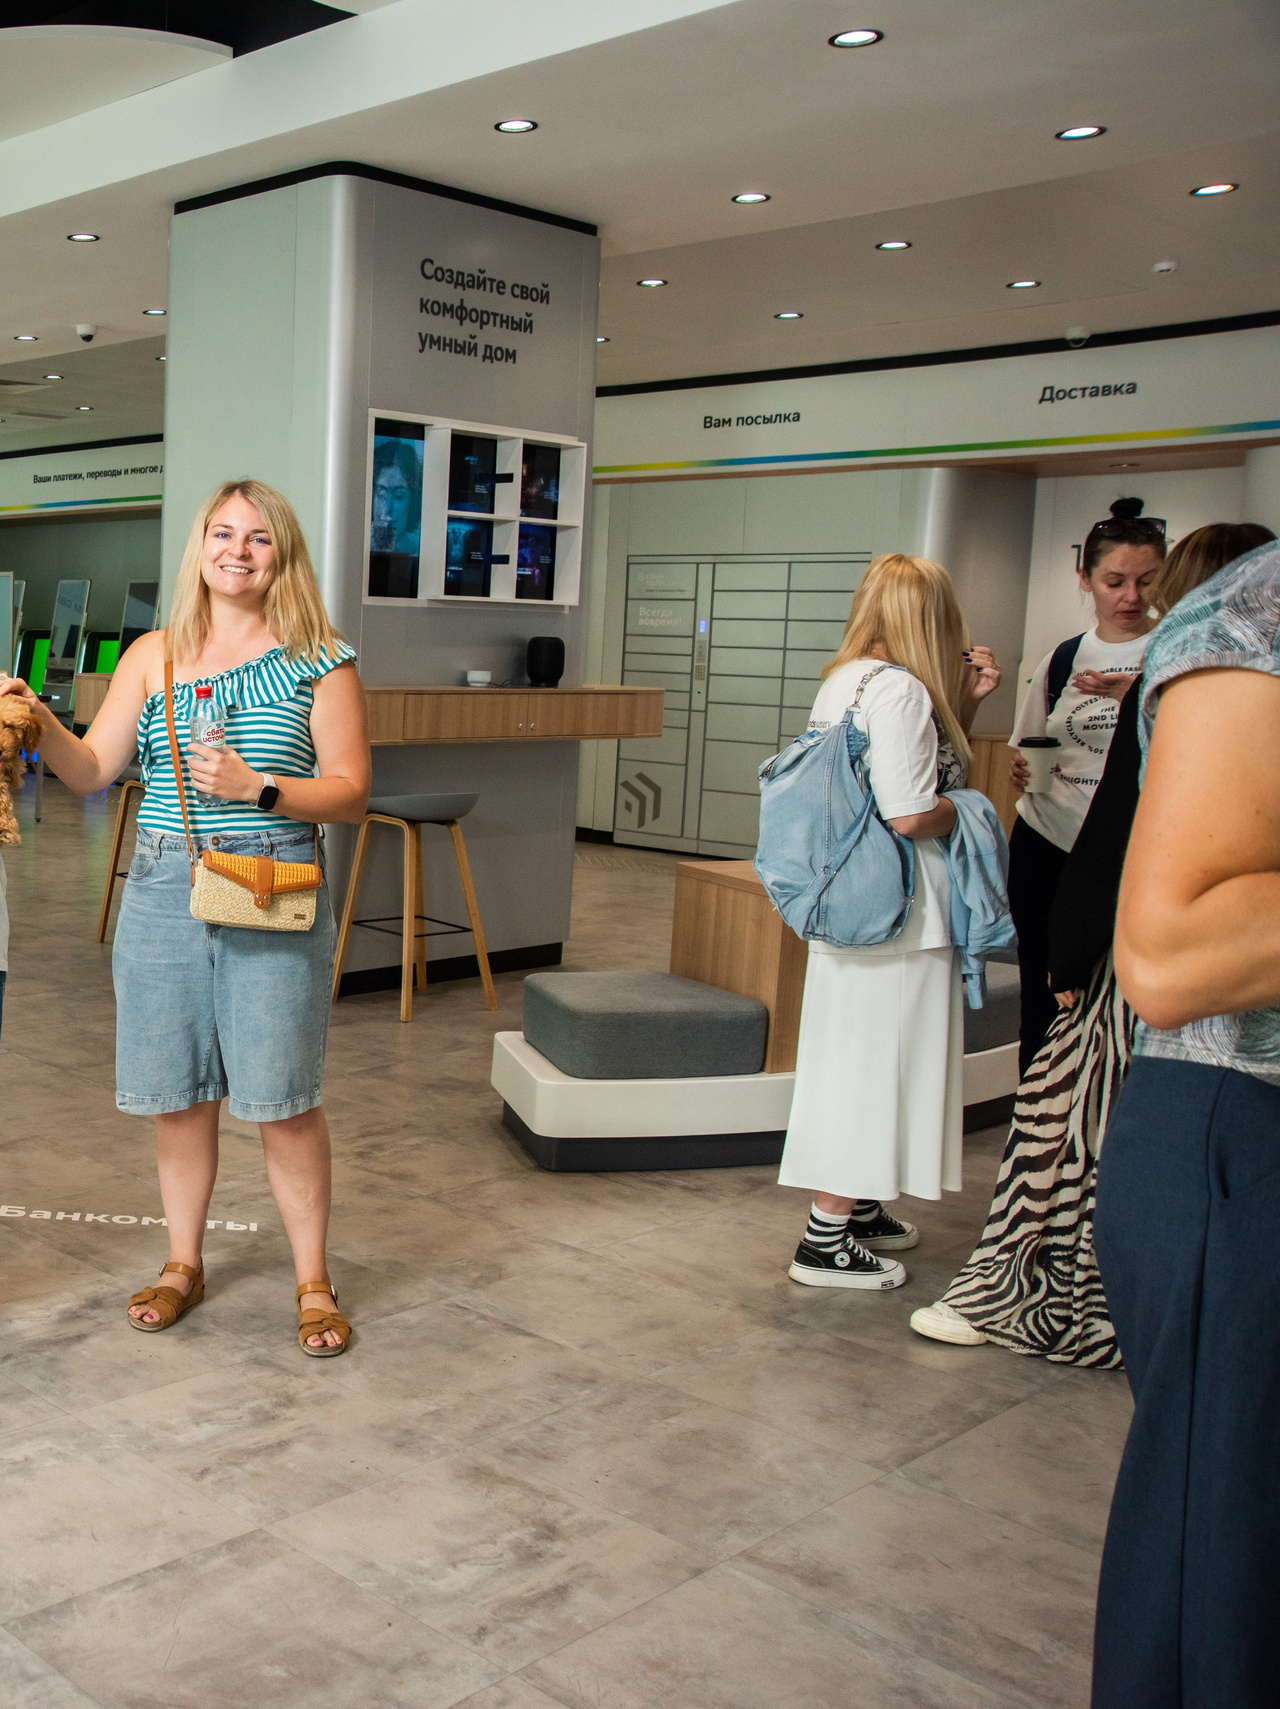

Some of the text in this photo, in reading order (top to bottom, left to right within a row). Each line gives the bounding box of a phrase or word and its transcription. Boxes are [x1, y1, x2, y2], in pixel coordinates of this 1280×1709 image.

[420, 258, 550, 305] Создайте свой
[420, 297, 533, 334] комфортный
[418, 332, 517, 364] умный дом
[1038, 382, 1138, 404] Доставка
[703, 412, 801, 429] Вам посылка
[33, 475, 51, 483] Ваши
[53, 472, 85, 482] платежи,
[86, 468, 122, 480] переводы
[131, 465, 158, 475] многое
[1088, 714, 1107, 722] 2ND
[1100, 705, 1116, 713] THE
[1082, 722, 1118, 731] MOVEM
